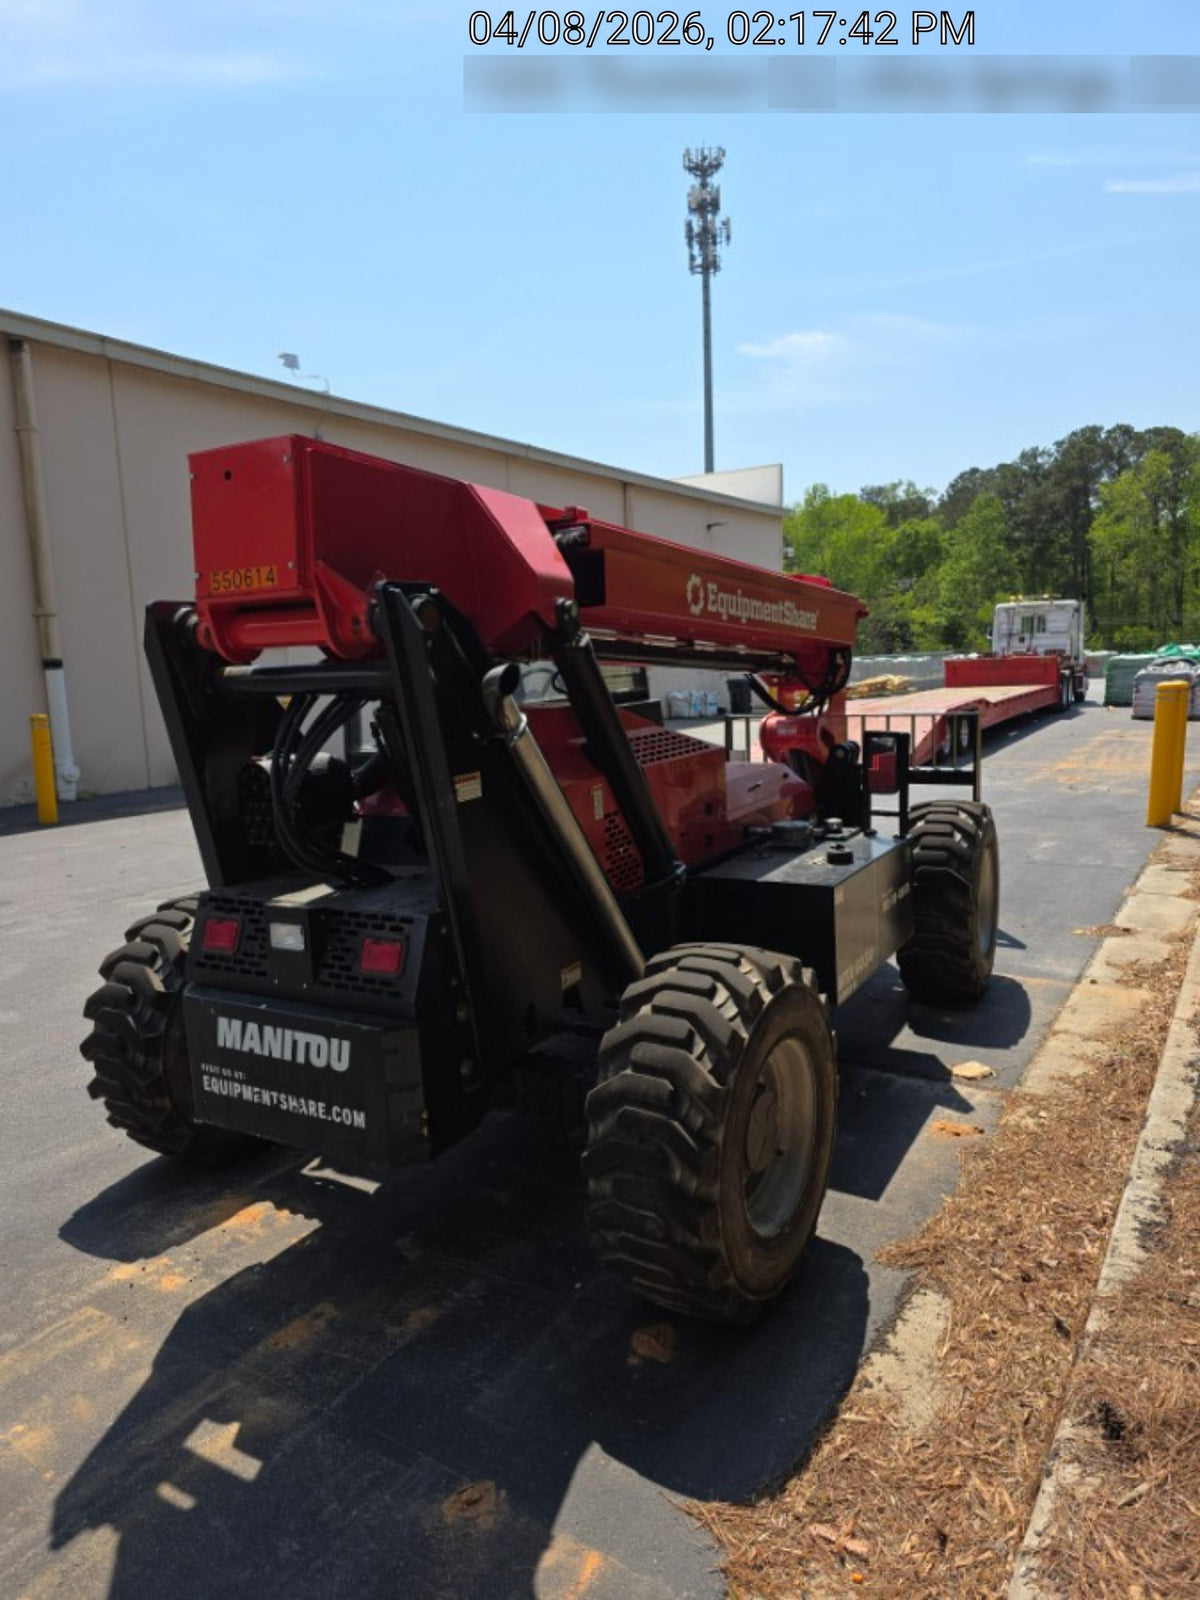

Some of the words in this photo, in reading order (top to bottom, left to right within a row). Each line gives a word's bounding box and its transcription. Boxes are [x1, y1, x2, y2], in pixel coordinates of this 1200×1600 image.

[210, 567, 276, 591] 550614
[706, 582, 818, 631] EquipmentShare
[216, 1016, 351, 1072] MANITOU
[201, 1074, 366, 1129] EQUIPMENTSHARE.COM
